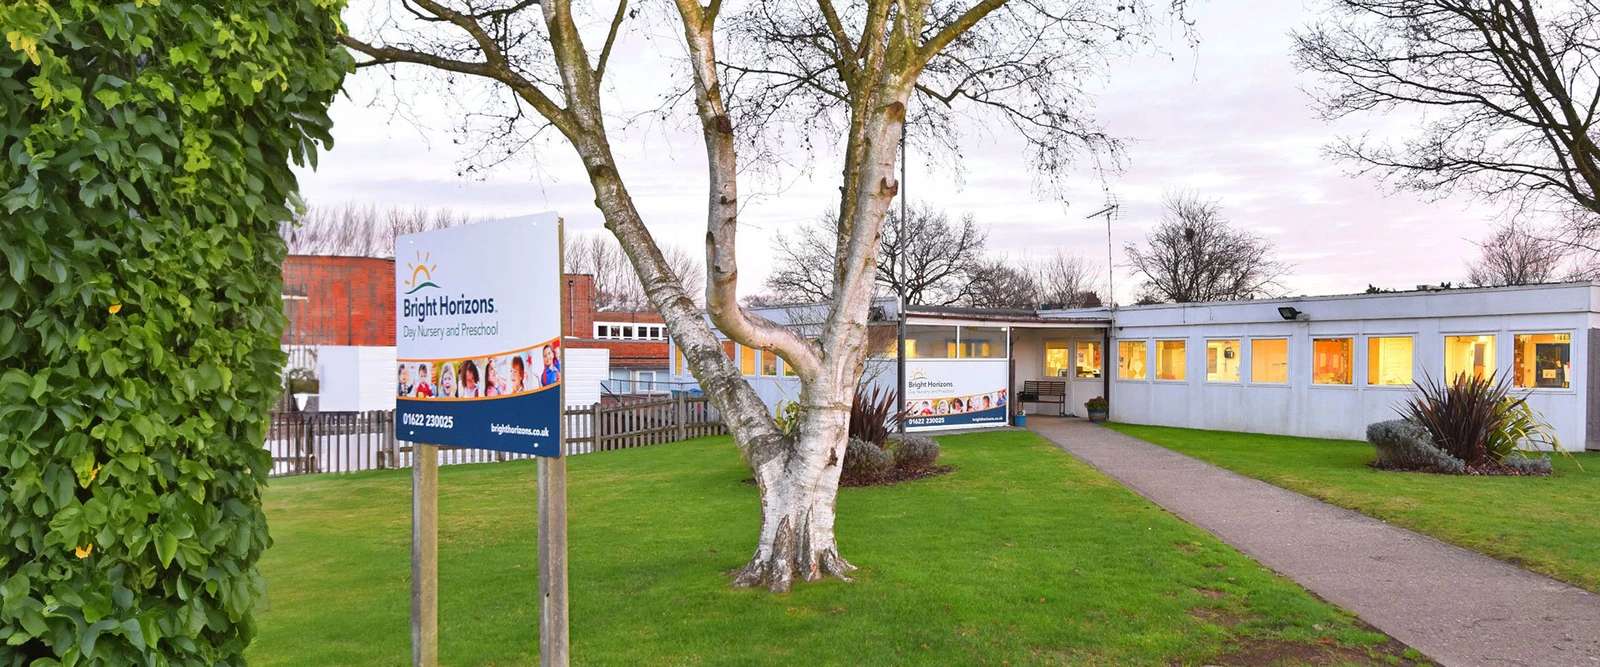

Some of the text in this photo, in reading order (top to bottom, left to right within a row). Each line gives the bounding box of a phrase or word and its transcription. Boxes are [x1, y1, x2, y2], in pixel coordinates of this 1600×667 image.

[404, 294, 494, 322] Bright Horizons
[403, 321, 498, 341] Day Nursery and Preschool
[908, 381, 927, 389] Bright
[403, 413, 454, 429] 01622 230025
[491, 423, 549, 437] brighthorizons.co.uk
